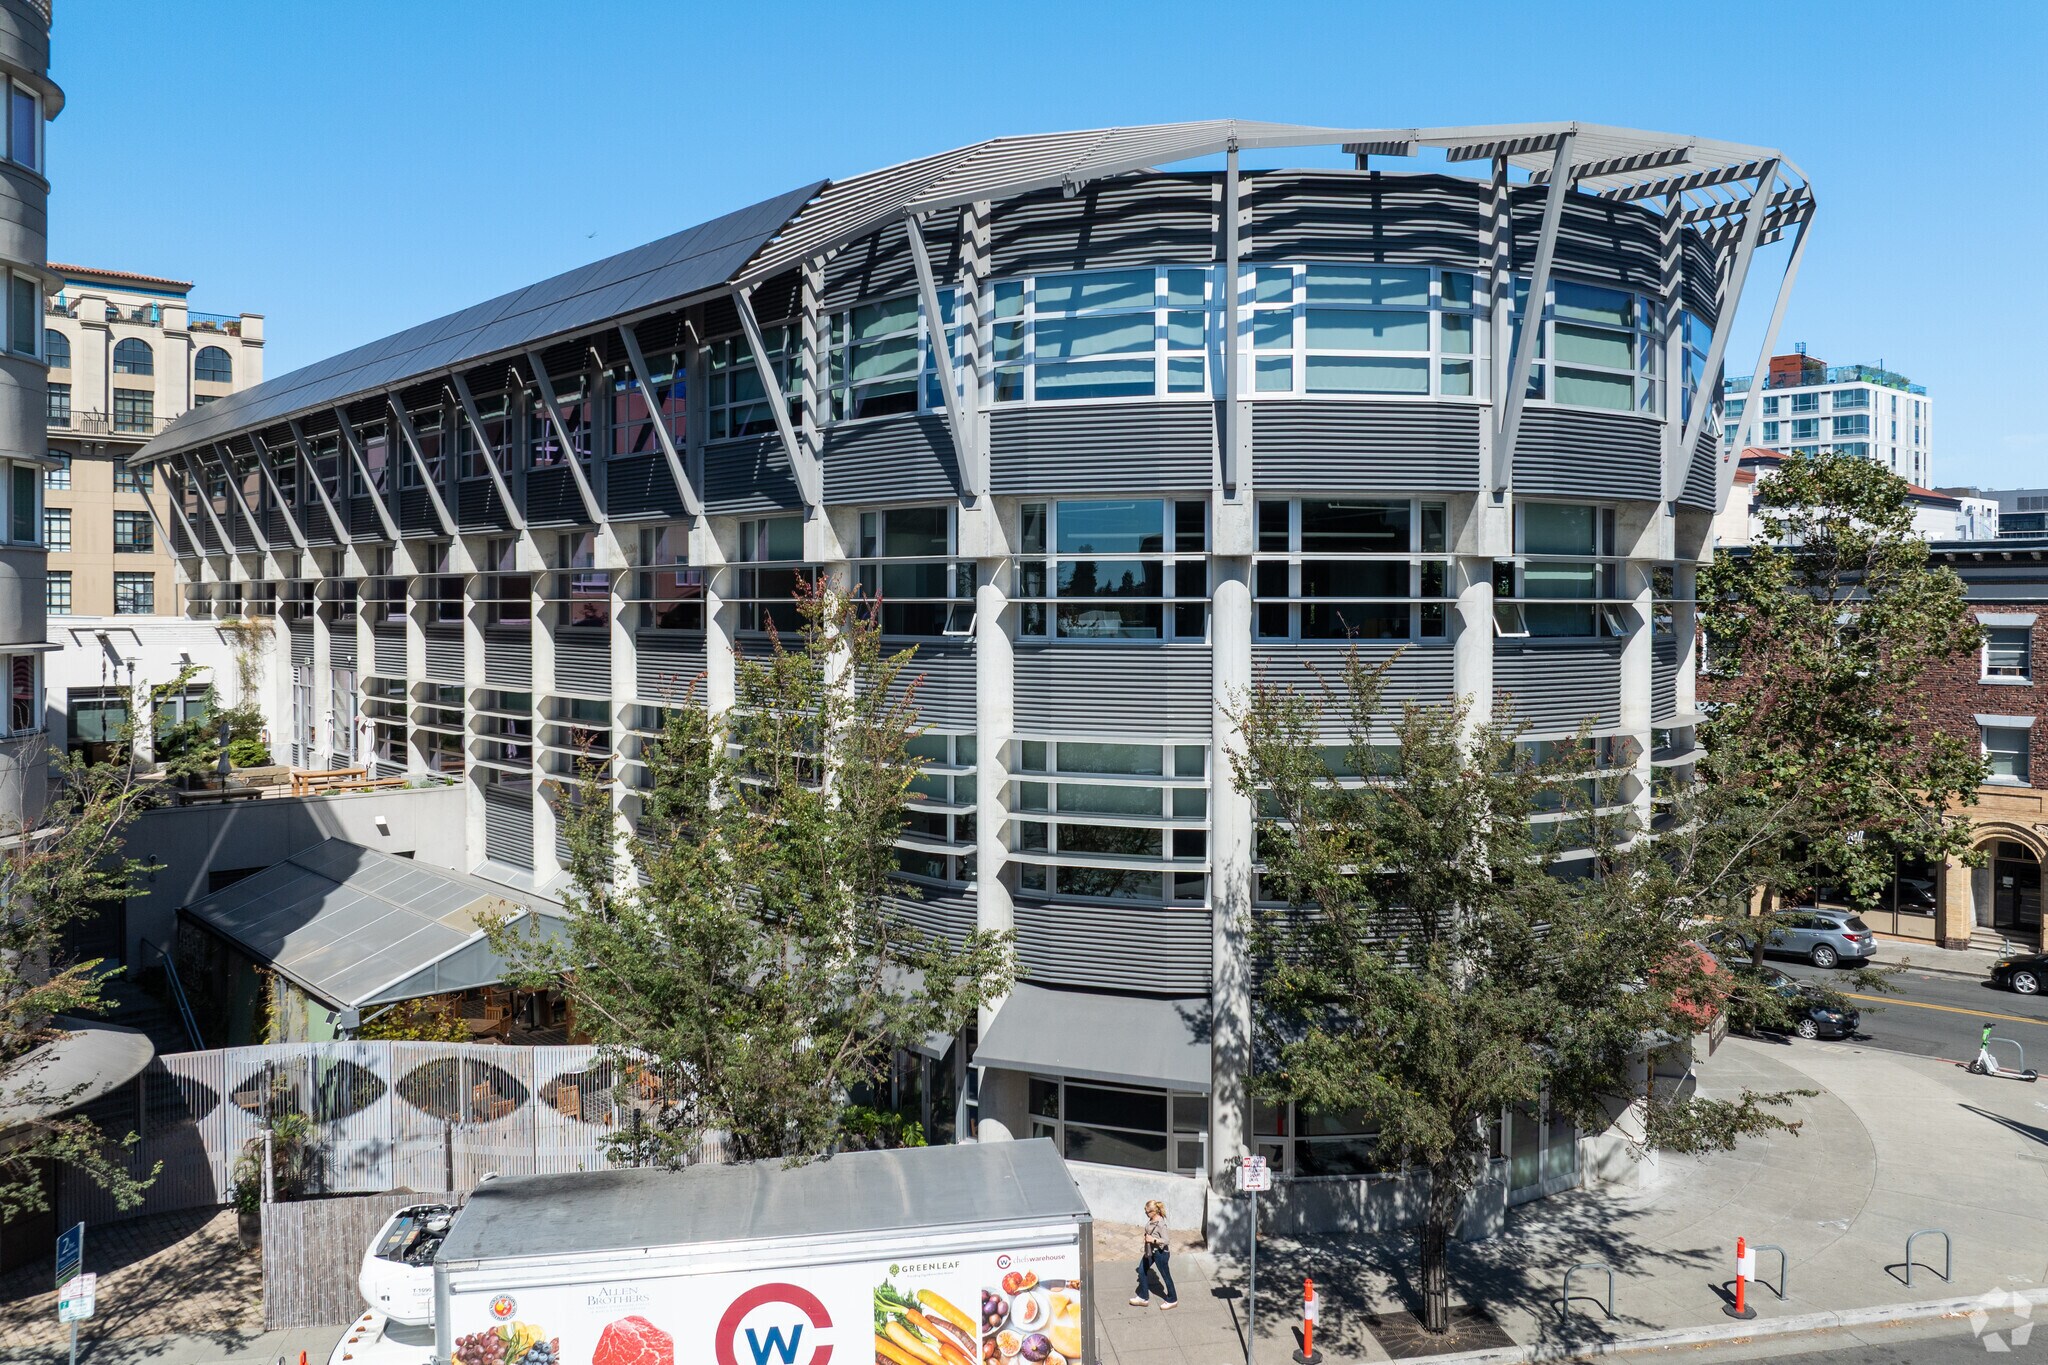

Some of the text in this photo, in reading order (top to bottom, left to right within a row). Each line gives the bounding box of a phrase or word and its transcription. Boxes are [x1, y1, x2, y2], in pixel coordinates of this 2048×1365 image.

[62, 1237, 70, 1254] 2
[901, 1261, 960, 1273] GREENLEAF
[598, 1287, 640, 1297] ALLEN
[587, 1295, 650, 1306] BROTHERS
